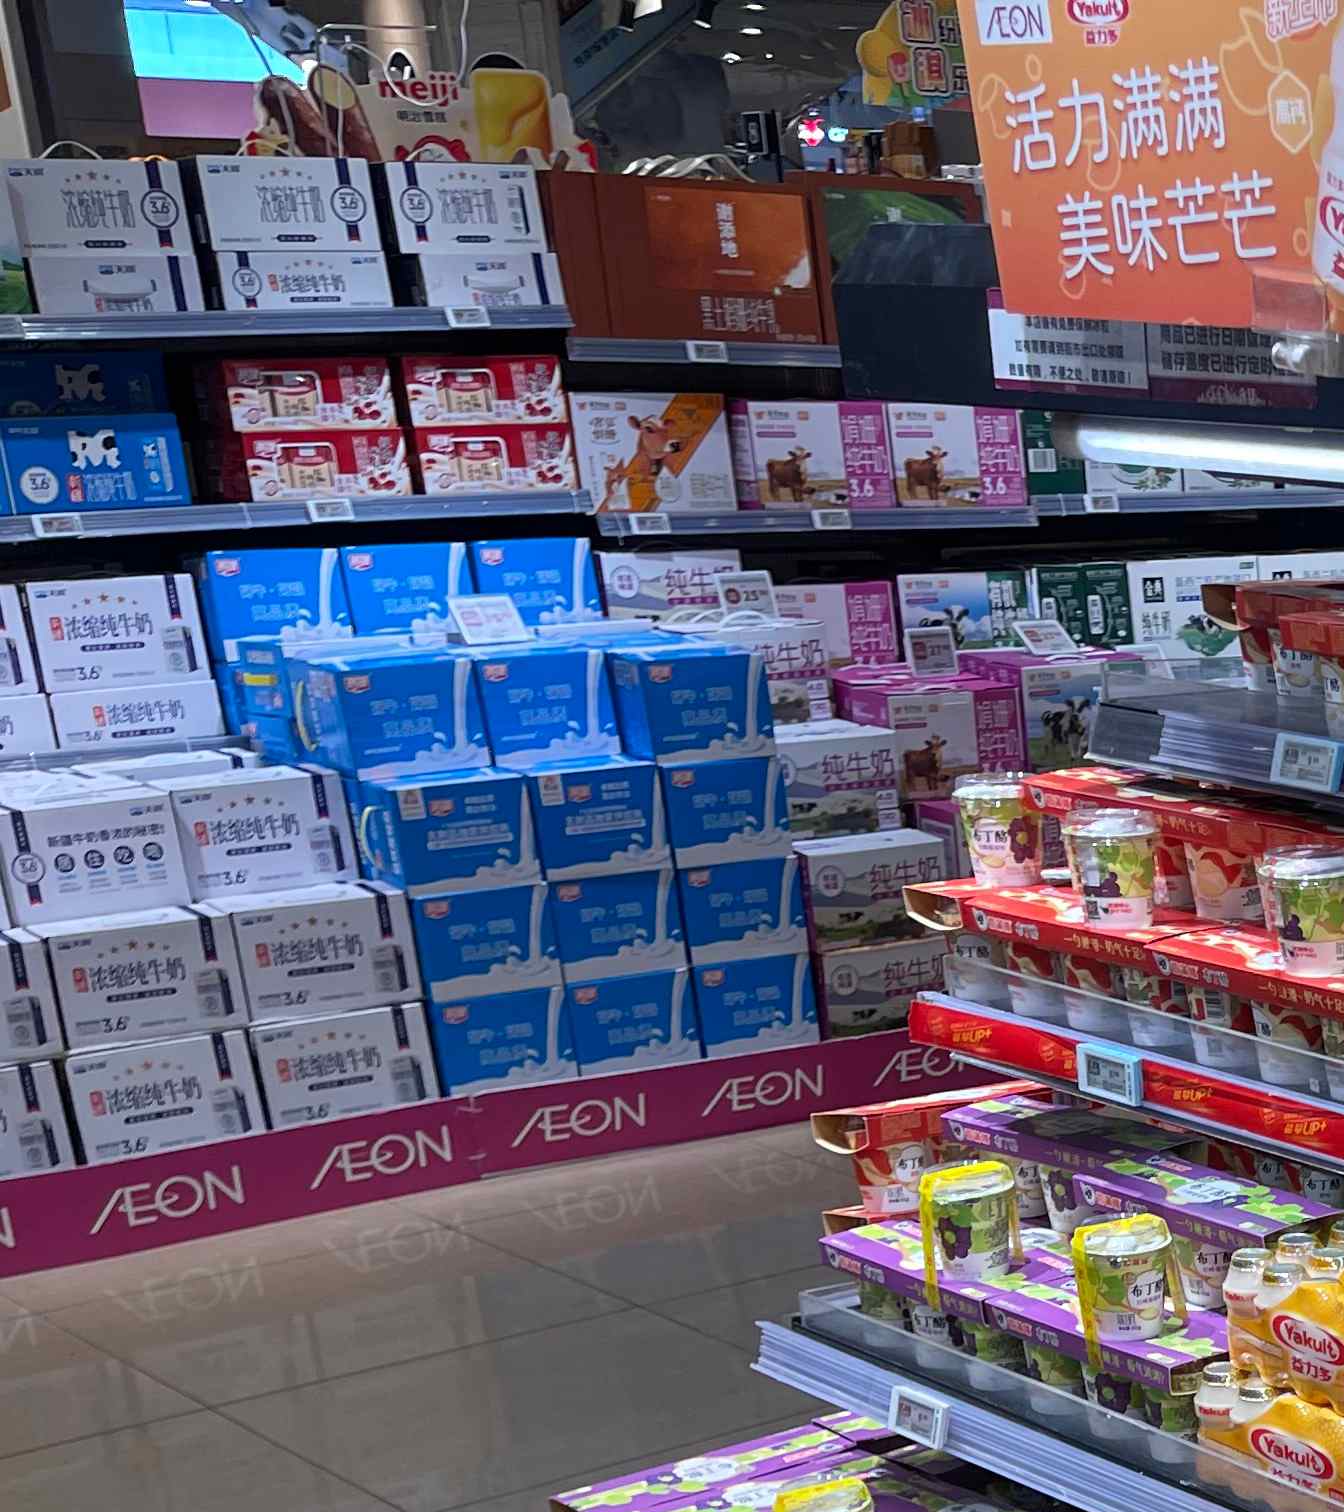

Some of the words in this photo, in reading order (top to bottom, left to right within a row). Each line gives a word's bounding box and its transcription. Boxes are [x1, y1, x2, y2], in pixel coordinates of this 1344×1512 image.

[1076, 1, 1120, 17] Yakult
[379, 75, 459, 107] meiji
[1005, 56, 1226, 173] 活力满满
[1057, 169, 1276, 282] 美味芒芒
[849, 479, 875, 498] 3.6
[984, 476, 1006, 496] 3.6
[64, 613, 153, 640] 浓缩纯牛奶
[106, 700, 184, 726] 浓缩纯牛奶
[822, 751, 896, 781] 纯牛奶
[210, 814, 300, 847] 浓缩纯牛奶
[870, 855, 941, 891] 纯牛奶
[271, 934, 364, 968] 浓缩纯牛奶
[89, 957, 186, 992] 浓缩纯牛奶
[292, 1046, 381, 1081] 浓缩纯牛奶
[107, 1075, 201, 1112] 浓缩纯牛奶
[1282, 1322, 1338, 1357] Yakult
[1290, 1357, 1332, 1382] 益力多
[1262, 1437, 1323, 1472] Yakult
